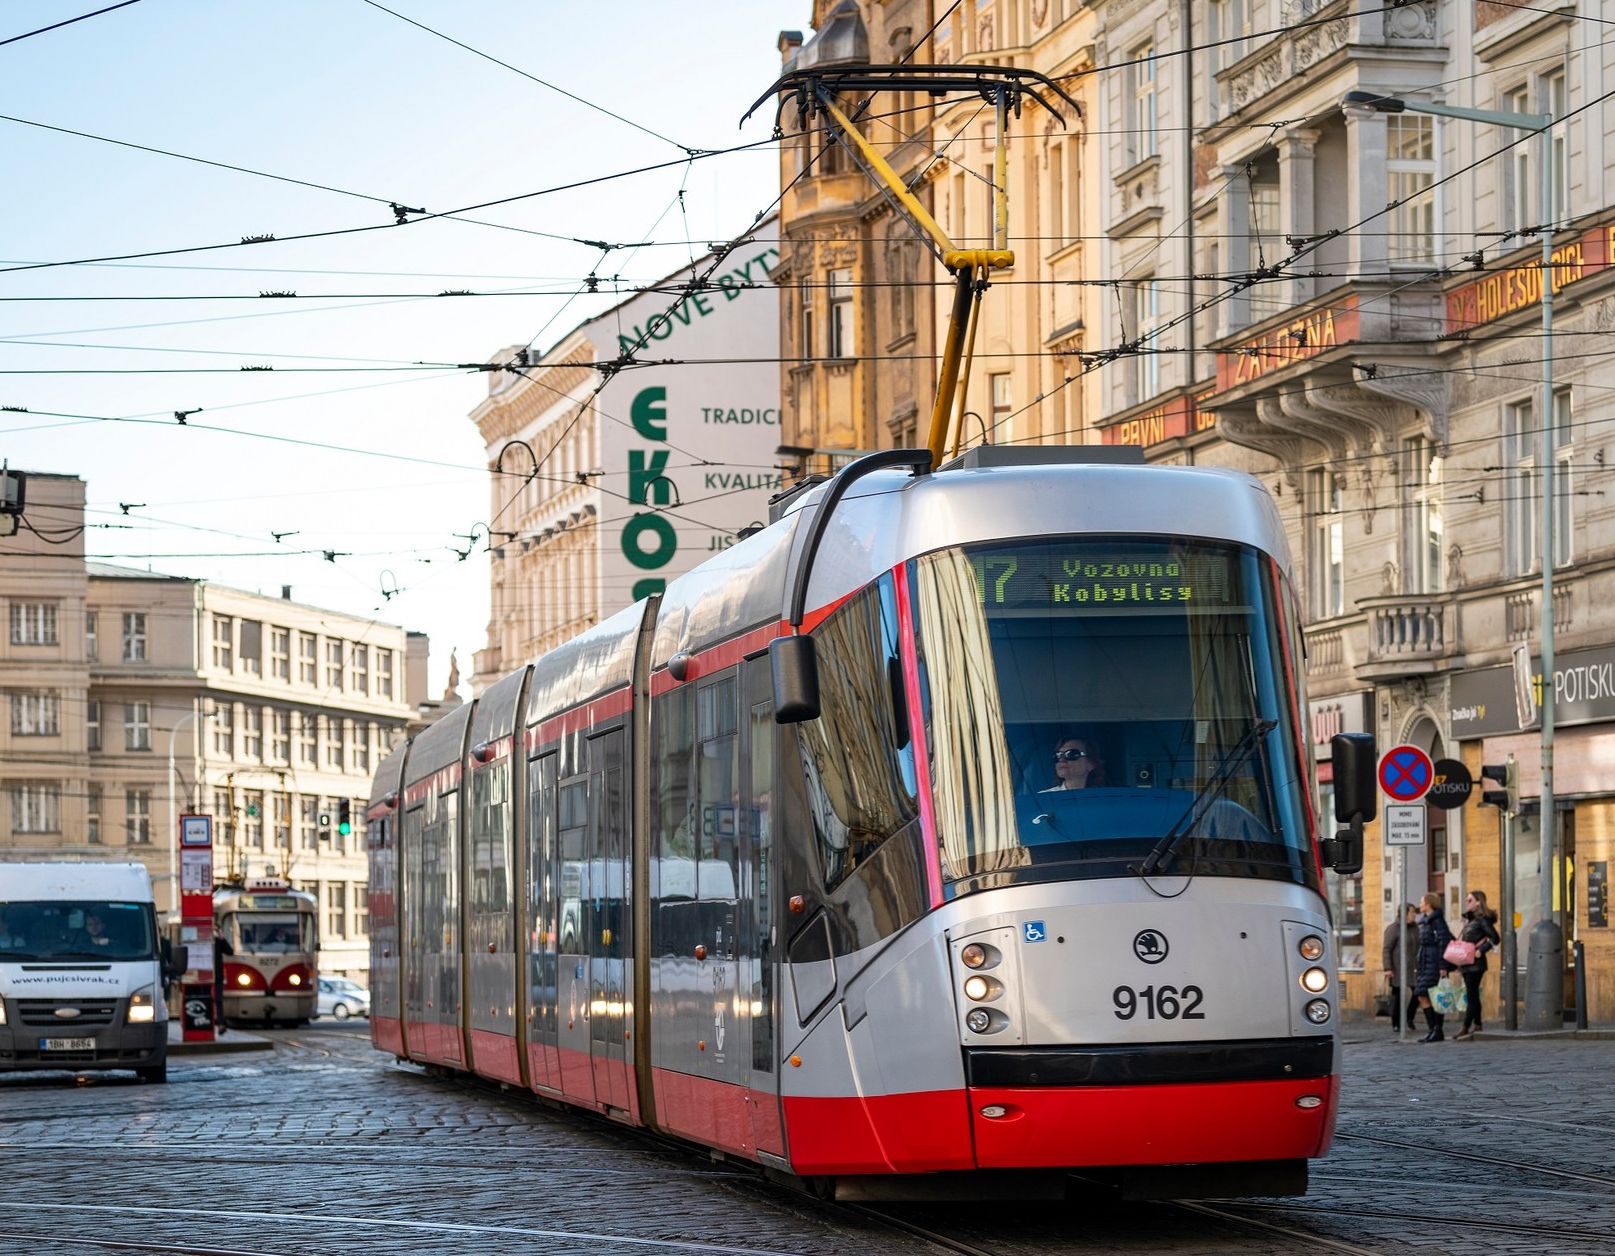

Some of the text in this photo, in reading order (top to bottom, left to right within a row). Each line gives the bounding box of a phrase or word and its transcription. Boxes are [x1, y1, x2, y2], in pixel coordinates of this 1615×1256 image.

[1063, 559, 1180, 577] Vozovna
[1054, 583, 1192, 602] Kobylisy
[1112, 985, 1205, 1020] 9162
